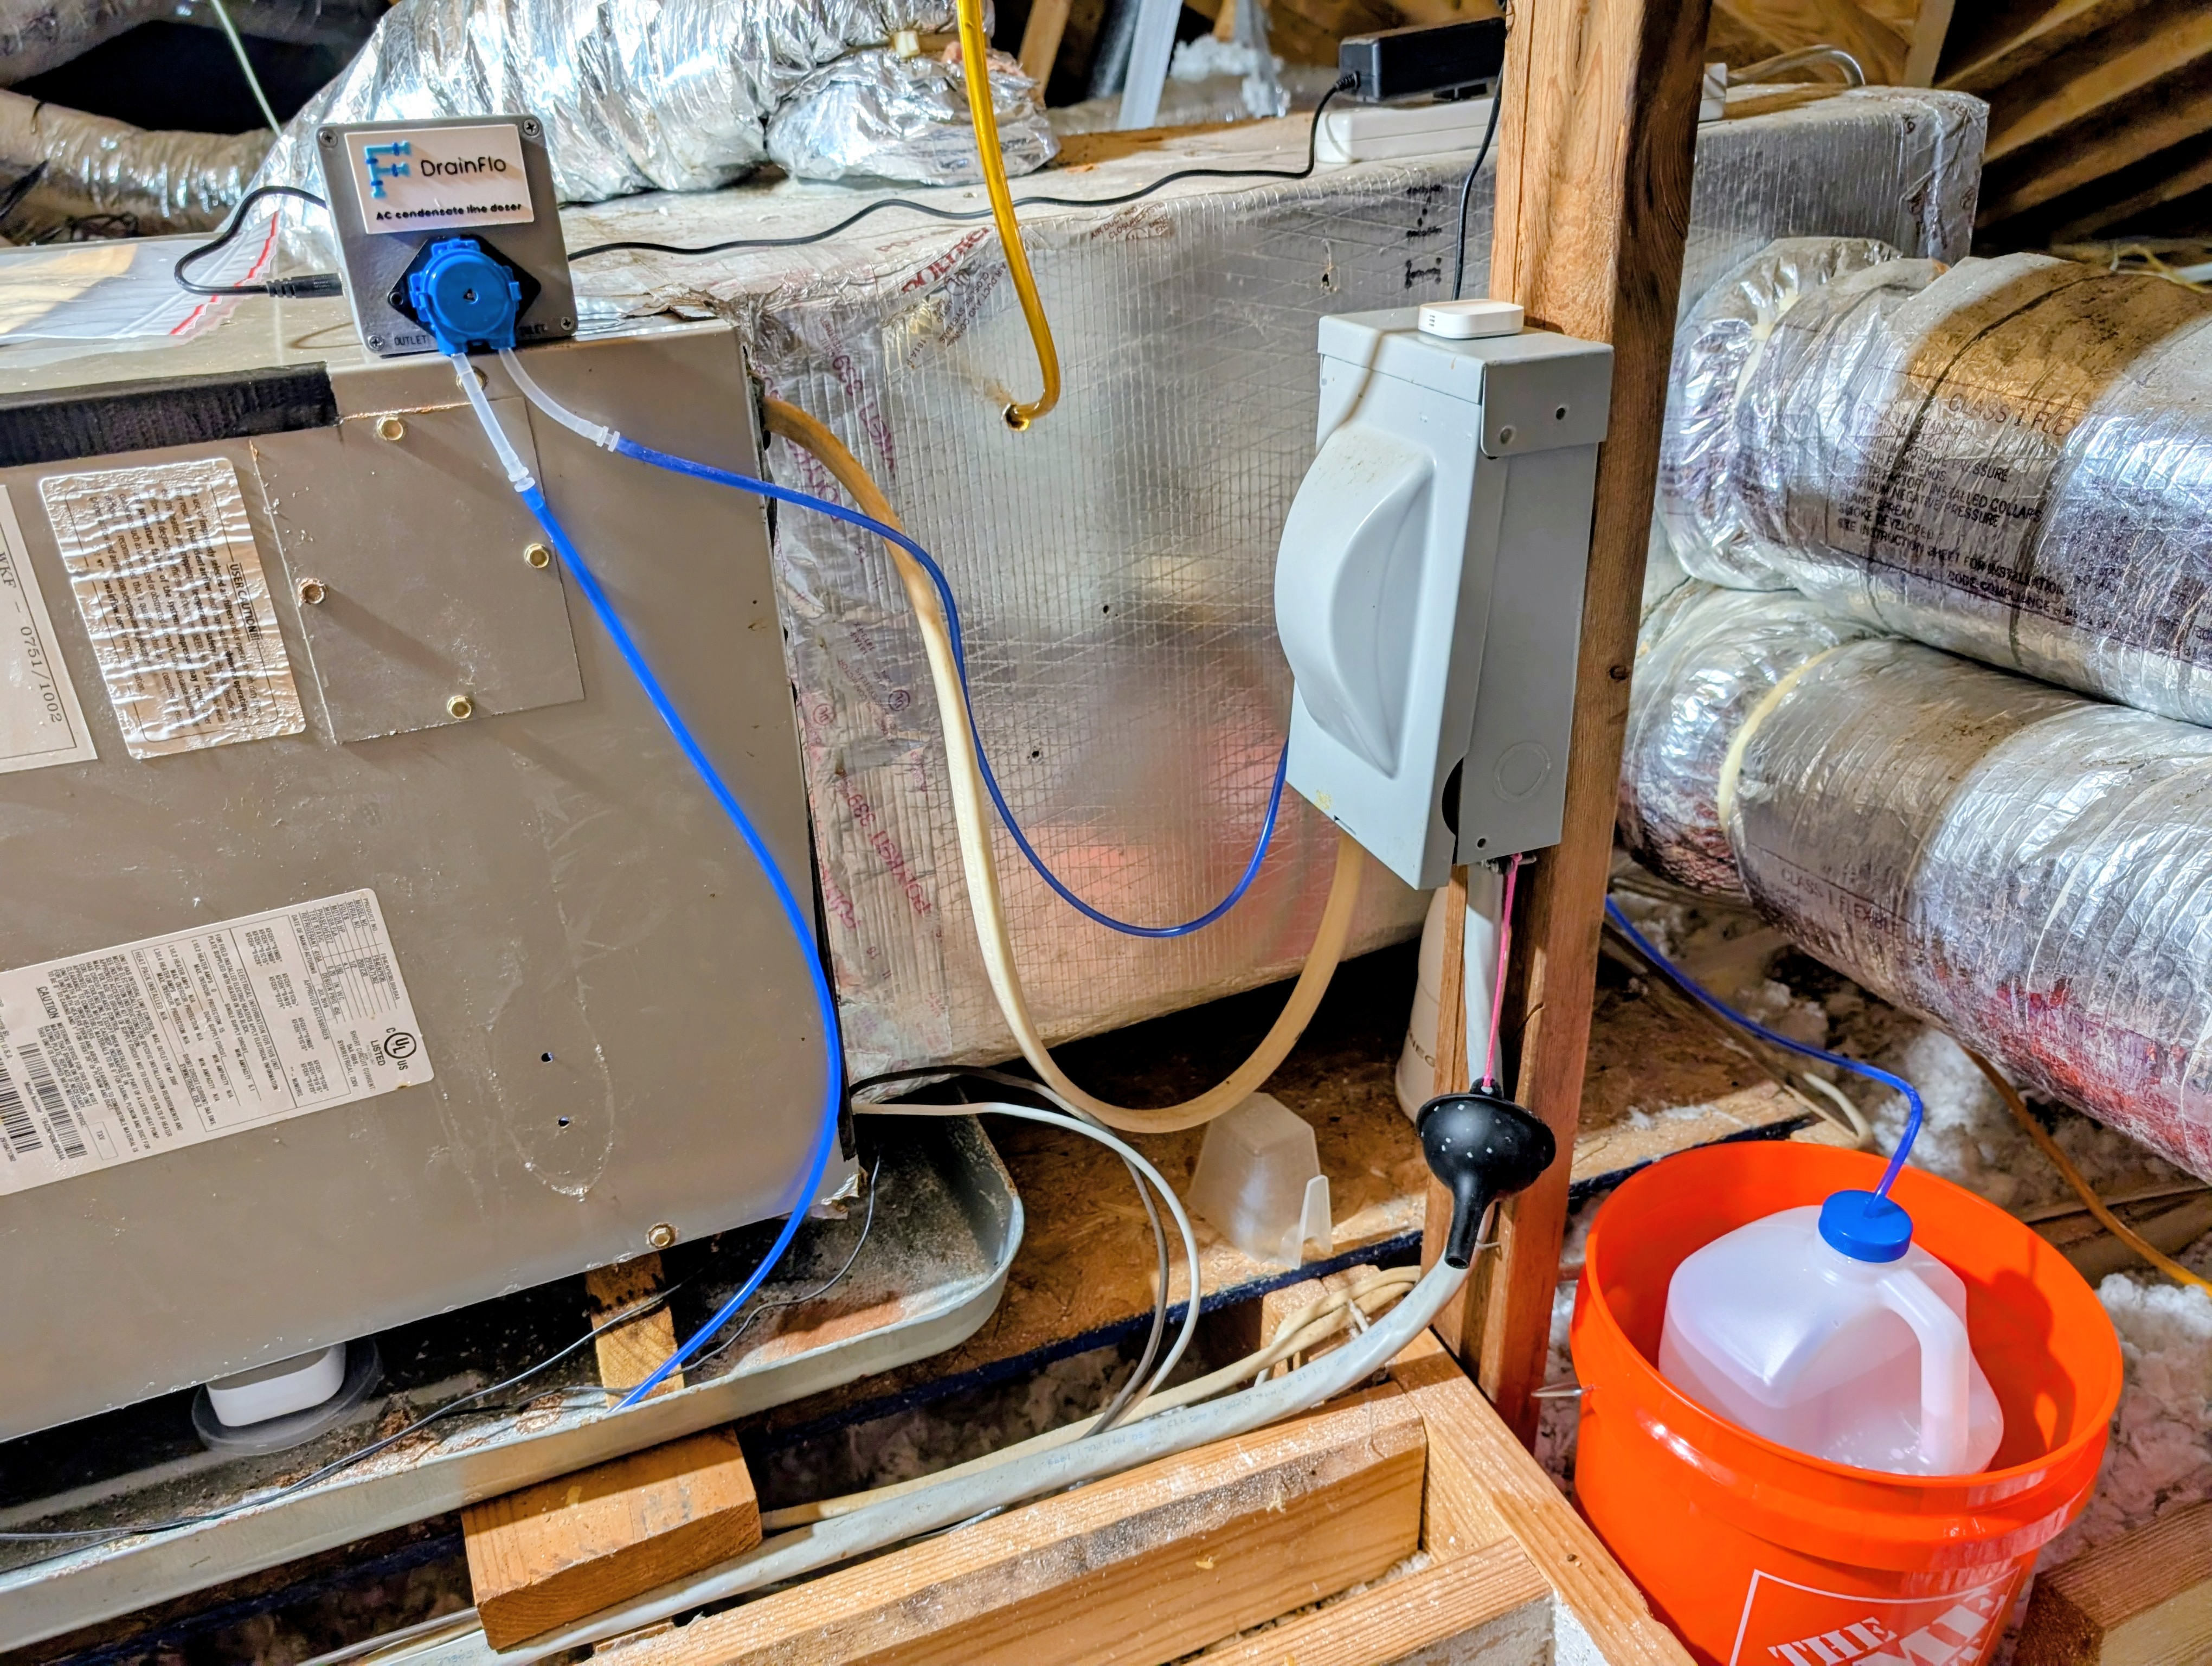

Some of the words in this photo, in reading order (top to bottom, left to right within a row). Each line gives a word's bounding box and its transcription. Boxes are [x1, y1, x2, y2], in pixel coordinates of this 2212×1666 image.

[421, 156, 506, 177] DrainFlo
[376, 211, 392, 220] AC
[395, 206, 464, 220] condensate
[466, 204, 487, 213] line
[490, 203, 522, 212] doser
[1089, 227, 1104, 239] AIR
[1102, 215, 1123, 231] DUCT
[994, 262, 1008, 278] AIR
[961, 271, 991, 307] CLOSURE
[979, 277, 999, 299] DUCT
[967, 298, 983, 318] AND
[936, 306, 967, 343] SYSTEMS
[394, 335, 427, 346] OUTLET
[830, 353, 865, 397] 339
[1949, 392, 2008, 424] CLASS
[158, 574, 169, 583] of
[211, 559, 226, 586] selected
[223, 599, 235, 619] filters
[229, 563, 244, 588] USER
[162, 586, 172, 597] the
[166, 600, 181, 625] system
[203, 632, 217, 652] safety
[17, 625, 64, 723] 0751/1002
[234, 681, 249, 712] operation
[845, 791, 878, 828] 339
[324, 906, 335, 926] MOTOR
[331, 905, 342, 924] MOTOR
[337, 925, 345, 933] HP
[346, 901, 358, 920] SERIAL
[353, 921, 362, 930] NO.
[362, 898, 375, 922] PRODUCT
[308, 910, 318, 924] TEST
[313, 924, 325, 943] STATIC
[316, 908, 333, 944] PHASE/HERTZ
[338, 903, 350, 920] VOLTS
[357, 958, 368, 977] 208/230
[355, 899, 365, 919] MODEL
[361, 919, 369, 928] NO.
[372, 954, 386, 982] FB4CNP036
[291, 914, 300, 926] DATE
[298, 934, 317, 974] MANUFACTURING
[317, 988, 325, 997] JUL
[300, 912, 318, 947] REFRIGERANT
[313, 950, 323, 962] 410A
[321, 972, 333, 991] DESIGN
[327, 992, 337, 1004] PSIG
[134, 951, 145, 965] HEAT
[140, 966, 152, 981] PACK
[146, 981, 163, 1009] INSTALLED
[158, 1011, 168, 1021] N/A
[236, 968, 253, 998] ELECTRICAL
[37, 985, 60, 1018] CAUTION
[303, 979, 318, 1006] APPROVED
[312, 1006, 330, 1040] ACCESSORIES
[218, 944, 228, 957] FIELD
[223, 957, 237, 981] INSTALLED
[233, 982, 245, 1002] ELECTRIC
[241, 1003, 253, 1022] HEATERS
[248, 1023, 258, 1036] APPLY
[253, 1037, 267, 1061] ELECTRICAL
[262, 1062, 278, 1090] INFORMATION
[248, 999, 266, 1034] INFORMATION
[261, 1035, 270, 1045] FOR
[265, 1046, 274, 1058] THIS
[350, 1030, 361, 1046] SHORT
[356, 1047, 367, 1066] CIRCUIT
[370, 1040, 386, 1066] LISTED
[270, 1058, 279, 1071] UNIT
[397, 1059, 408, 1071] US
[292, 1078, 303, 1097] NUMERIC
[349, 1075, 358, 1087] 230V
[95, 1130, 105, 1140] TXV
[1767, 1616, 1898, 1666] THE
